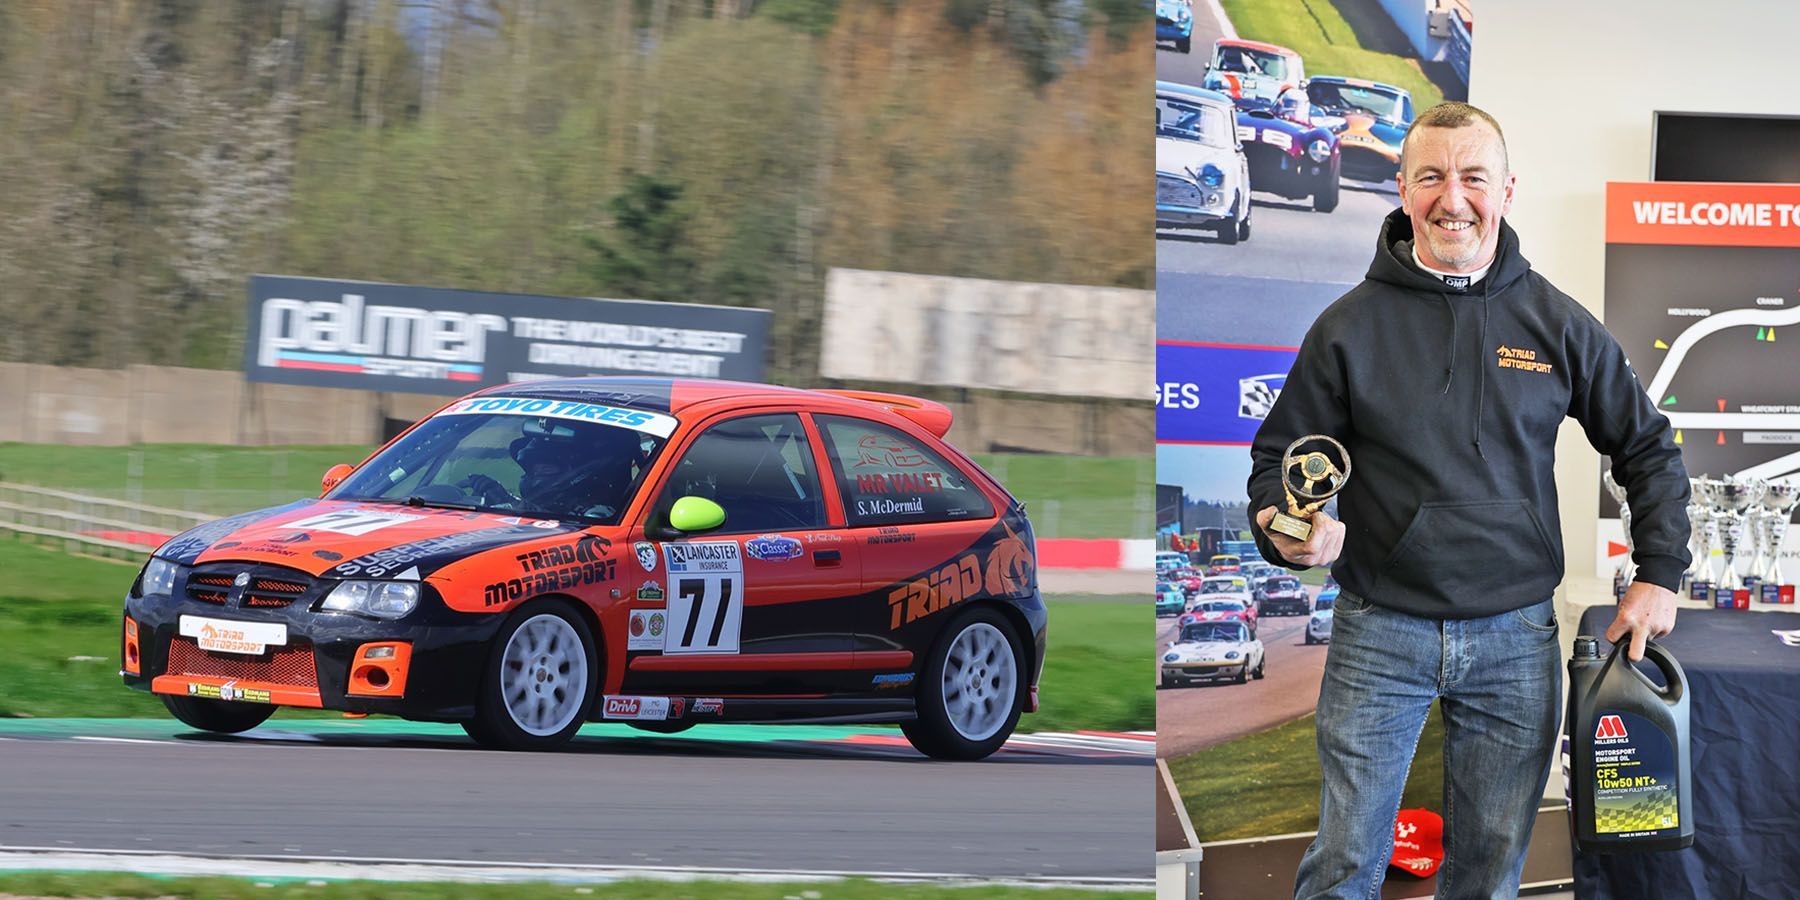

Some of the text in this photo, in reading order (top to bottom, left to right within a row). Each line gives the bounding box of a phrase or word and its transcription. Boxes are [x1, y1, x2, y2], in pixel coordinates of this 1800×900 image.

[1632, 201, 1772, 226] WELCOME
[257, 294, 508, 368] palmer
[1510, 348, 1536, 360] TRIAD
[1498, 358, 1552, 373] MOTORSPORT
[1156, 382, 1200, 409] ES
[464, 399, 553, 413] TOYO
[553, 402, 657, 426] TIRES
[856, 472, 945, 494] MR VALET
[858, 497, 924, 516] S. McDermid
[867, 533, 917, 545] MOTORSPORT
[685, 545, 737, 560] LANCASTER
[760, 541, 788, 555] Classic
[516, 544, 575, 572] TRIAD
[699, 561, 728, 570] INSURANCE
[484, 558, 617, 607] MOTORSPORT
[888, 553, 982, 630] TRIAD
[200, 637, 263, 652] MOTORSPORT
[609, 699, 637, 713] Drive
[1595, 748, 1636, 756] MOTORSPORT
[1596, 768, 1618, 779] CFS
[1597, 776, 1656, 789] 10w50 NT+
[1598, 787, 1628, 795] COMPETITION
[1643, 784, 1668, 792] SYNTHETIC
